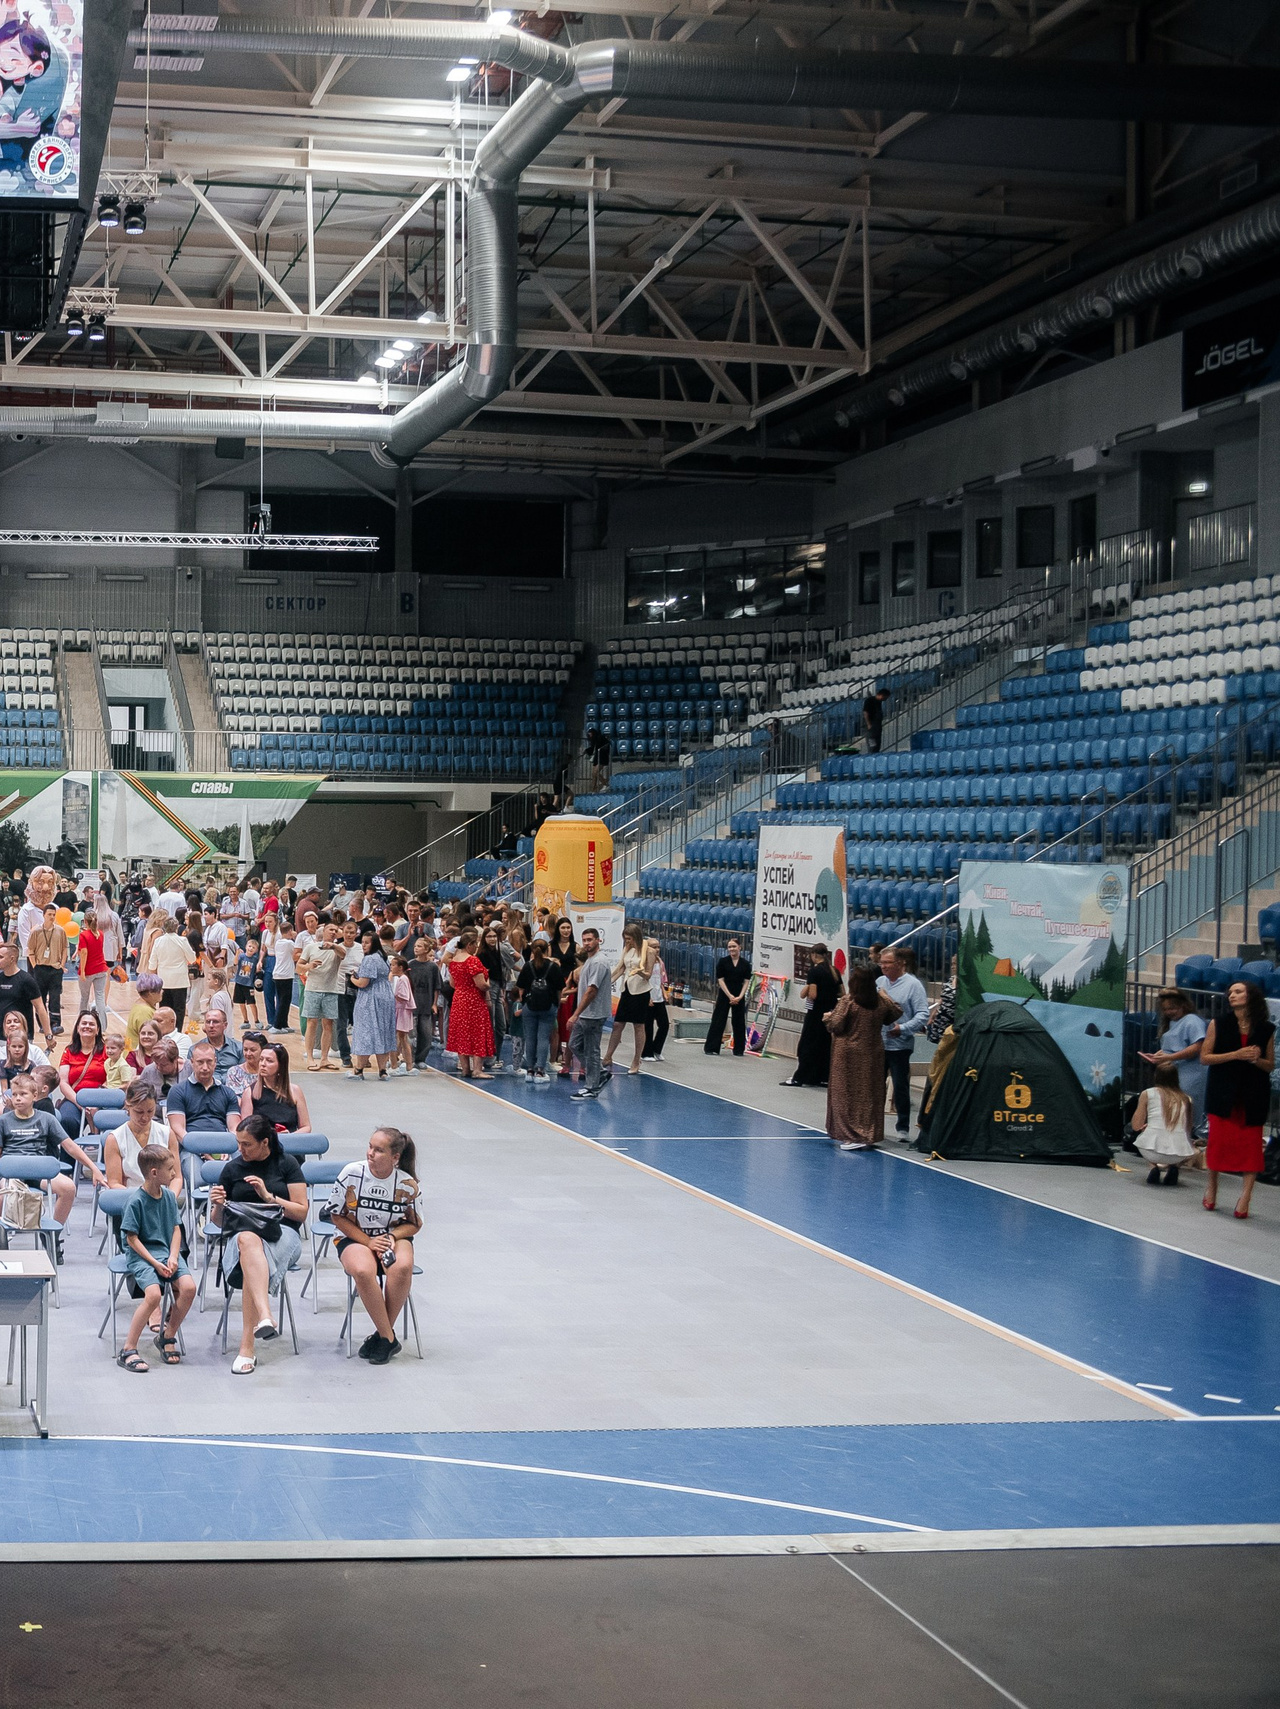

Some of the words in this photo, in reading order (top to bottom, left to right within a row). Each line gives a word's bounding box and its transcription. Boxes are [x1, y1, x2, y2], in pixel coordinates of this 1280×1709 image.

[1194, 337, 1264, 376] JÖGEL
[265, 596, 327, 611] СЕКТОР
[191, 782, 234, 794] славы
[763, 863, 795, 885] УСПЕЙ
[762, 889, 828, 912] ЗАПИСАТЬСЯ
[983, 884, 1008, 900] Живи,
[1010, 900, 1044, 919] Мечтай,
[761, 912, 769, 928] В
[770, 913, 817, 936] СТУДИЮ!
[1044, 918, 1110, 939] Путешествуй!
[993, 1110, 1045, 1123] BTrace
[371, 1188, 386, 1197] HI!
[360, 1199, 389, 1211] GIVE
